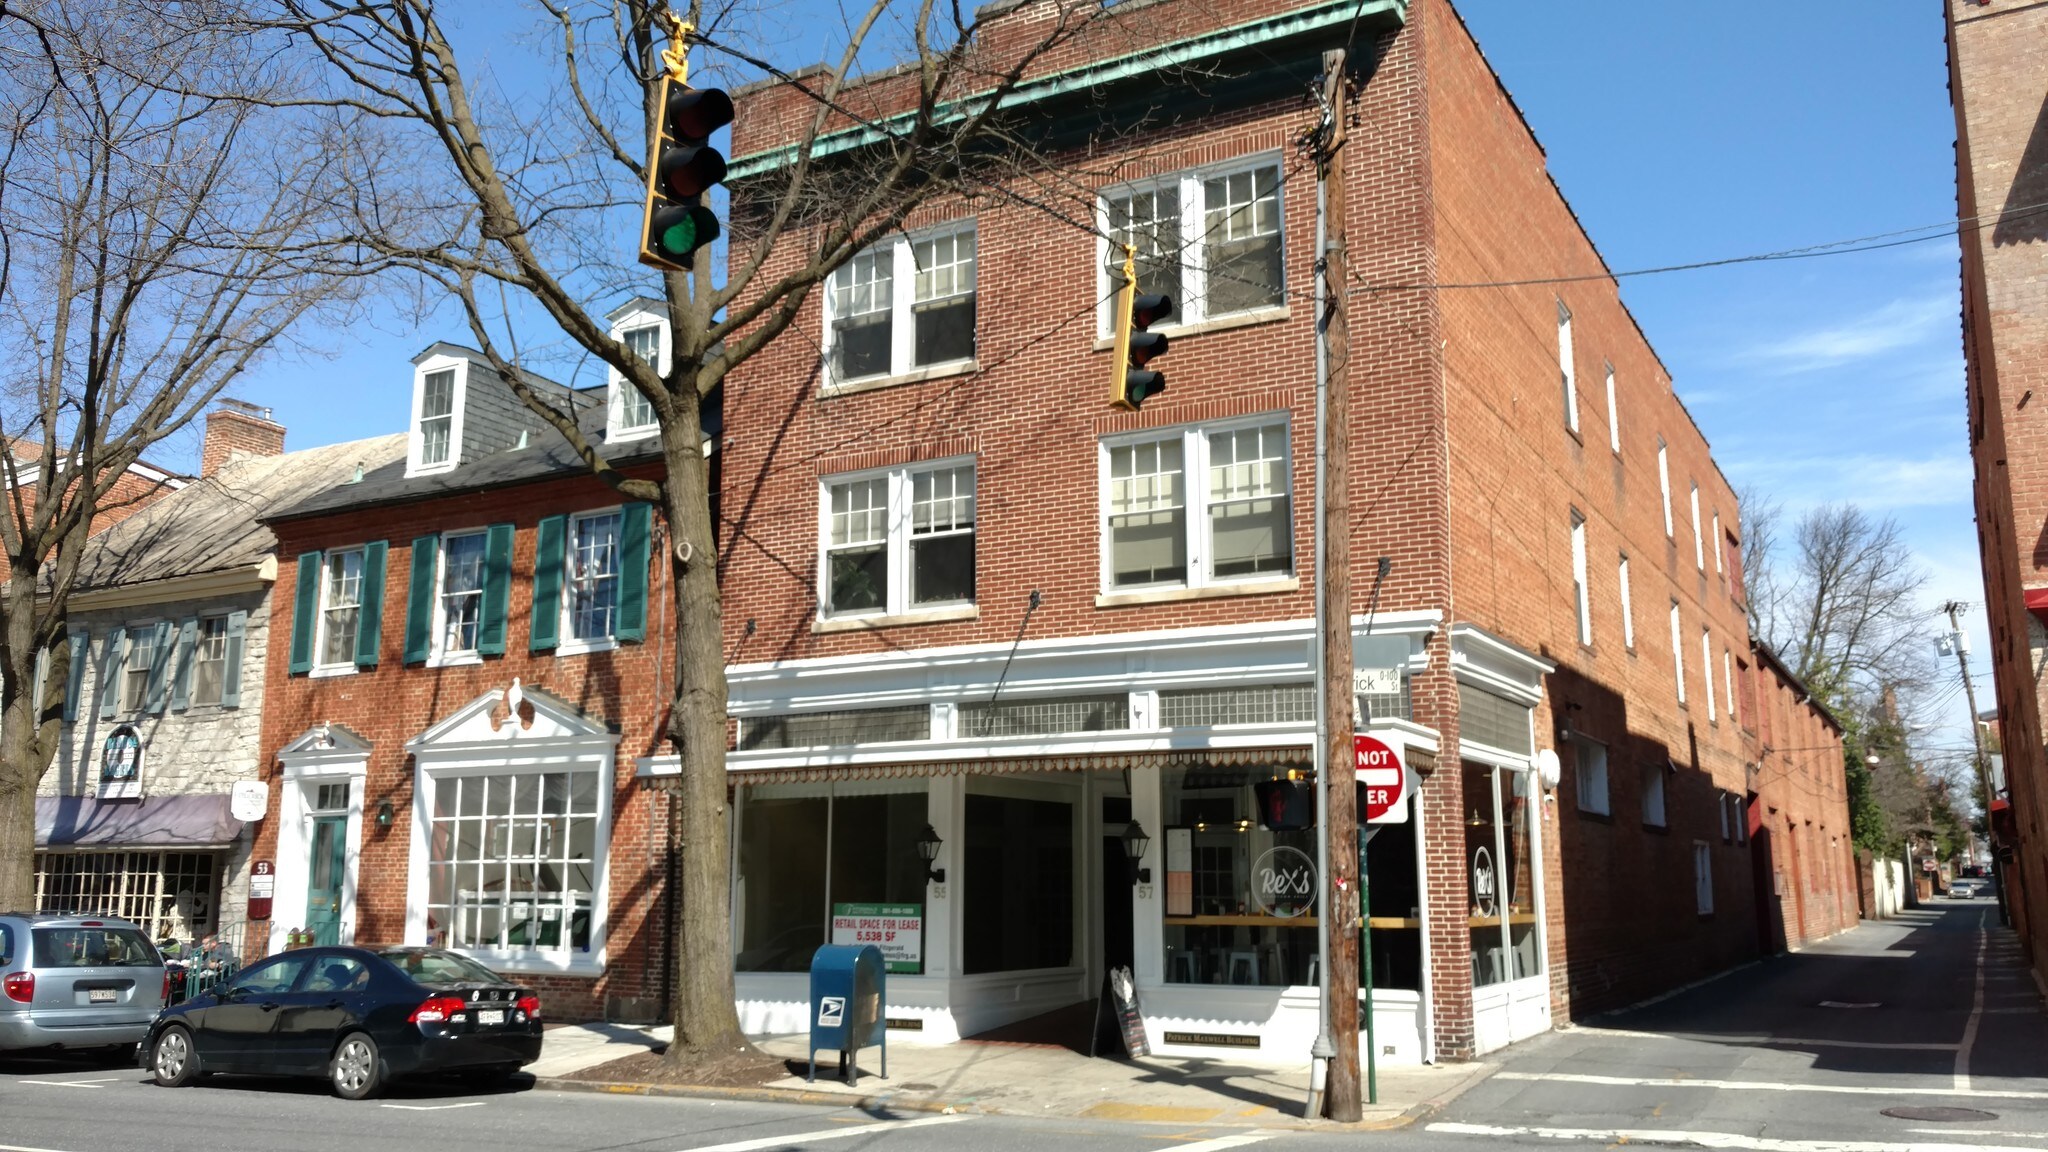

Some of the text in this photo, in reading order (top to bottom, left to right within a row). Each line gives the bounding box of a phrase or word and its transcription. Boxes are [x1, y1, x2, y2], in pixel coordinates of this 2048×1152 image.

[1357, 750, 1390, 766] NOT
[1367, 789, 1389, 805] ER
[257, 862, 269, 875] 53
[934, 886, 947, 899] 55
[1138, 886, 1154, 900] 57
[835, 918, 919, 931] RETAIL SPACE FOR LEASE
[857, 931, 897, 942] 5,538 SF
[1227, 1036, 1258, 1046] BUILDING
